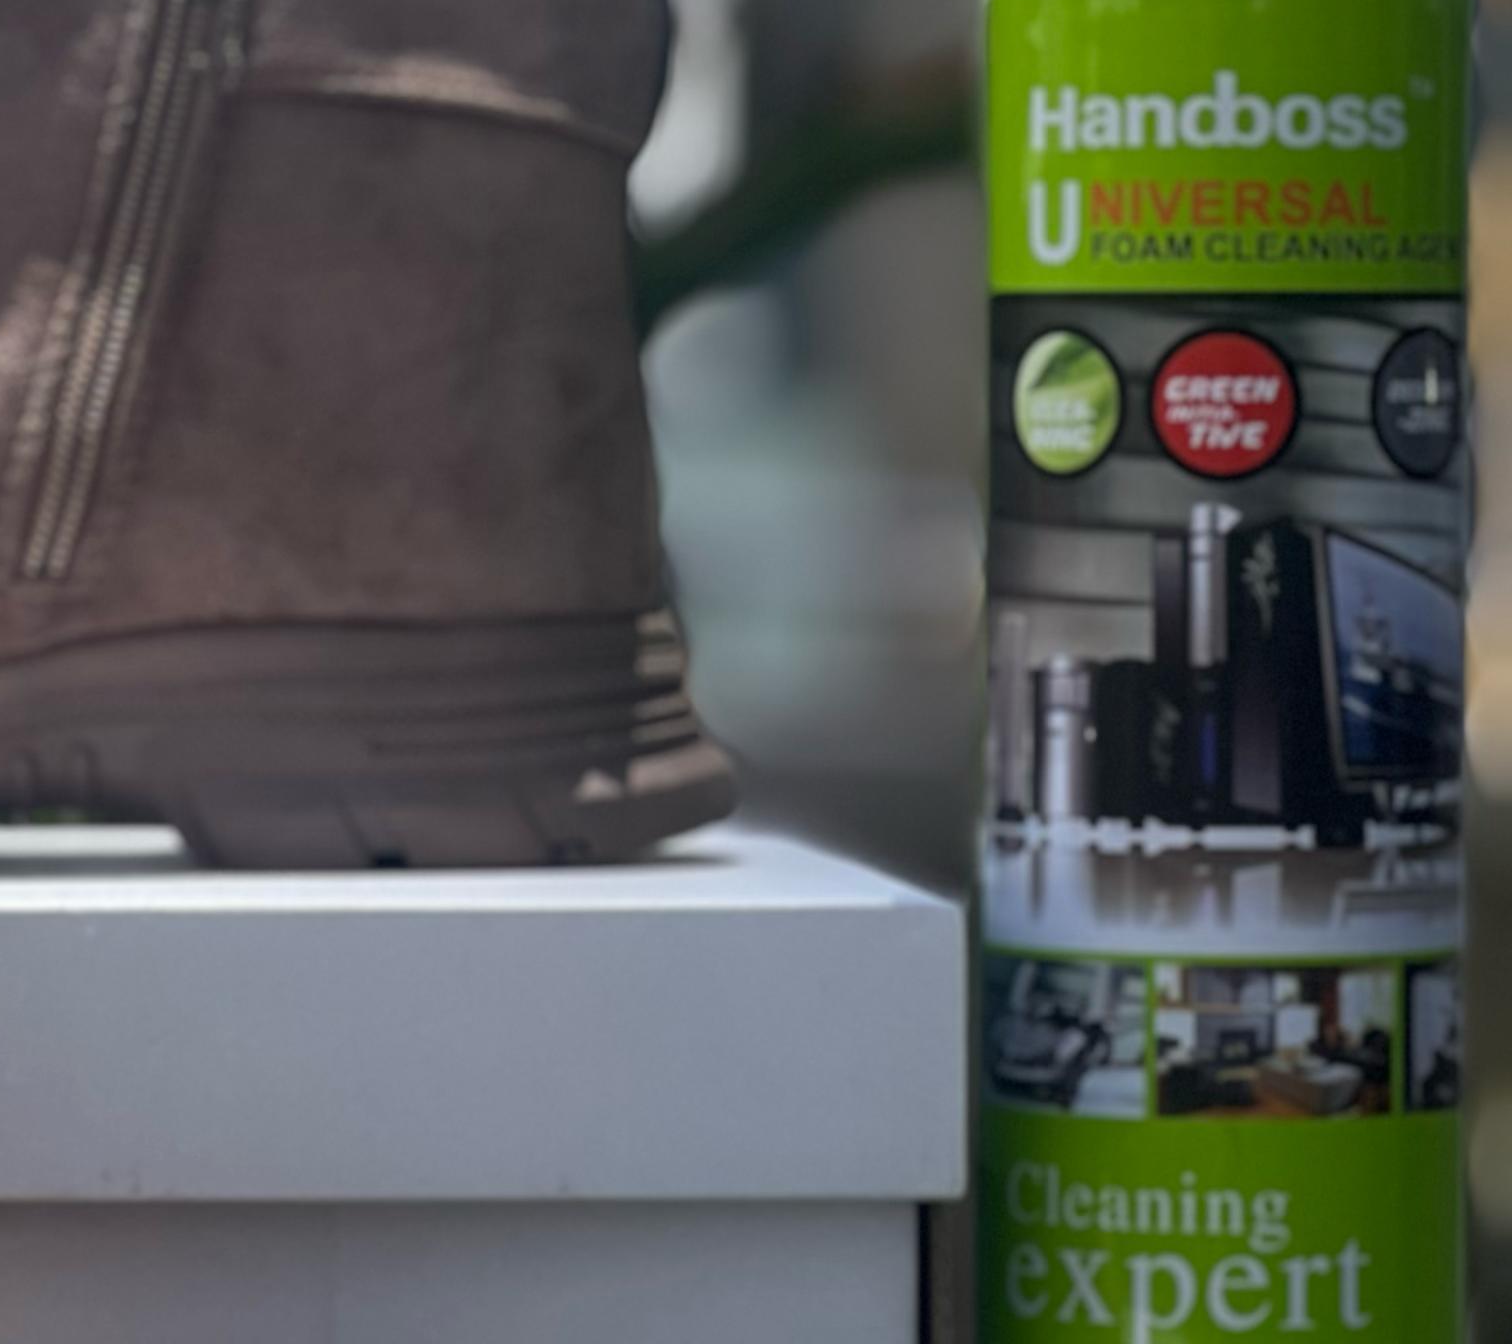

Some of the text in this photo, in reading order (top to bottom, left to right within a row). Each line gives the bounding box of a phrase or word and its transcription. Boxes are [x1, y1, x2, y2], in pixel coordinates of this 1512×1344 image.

[1029, 70, 1407, 152] Handboss
[1089, 232, 1194, 262] FOAM
[1203, 232, 1390, 263] CLEANING
[1005, 1160, 1290, 1253] Cleaning
